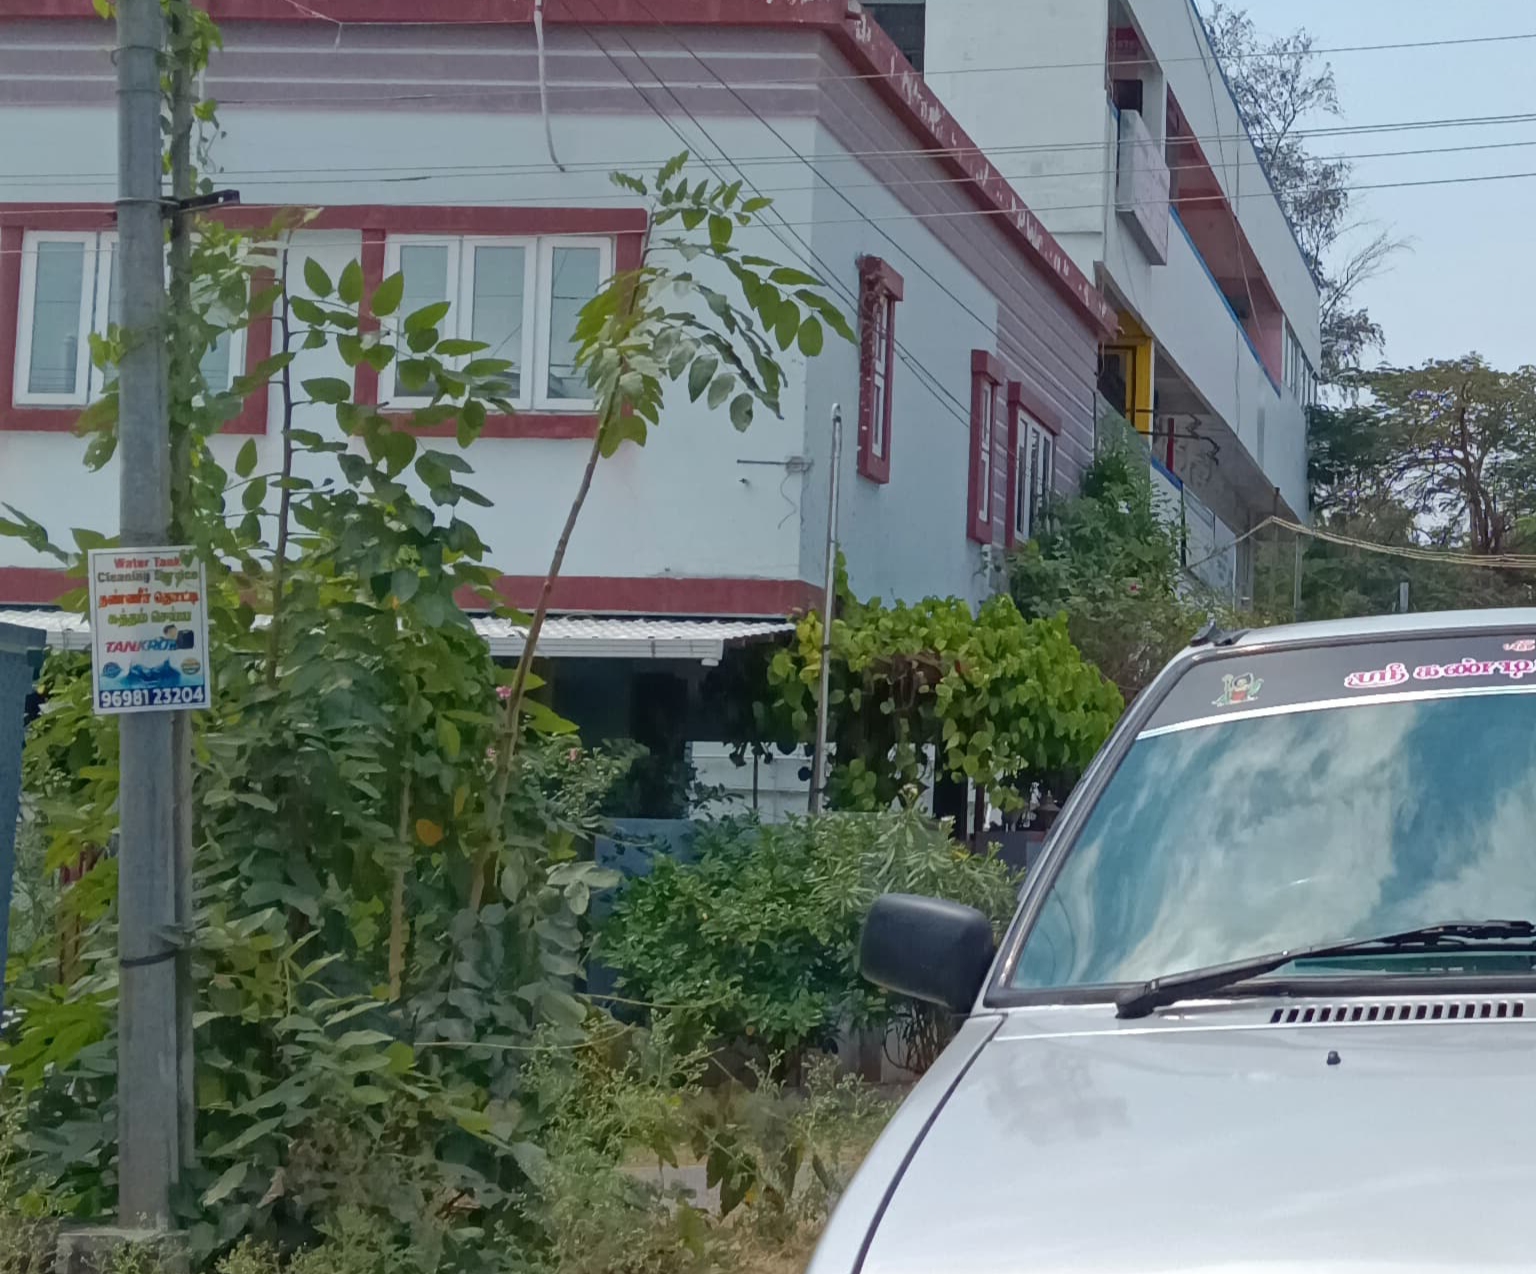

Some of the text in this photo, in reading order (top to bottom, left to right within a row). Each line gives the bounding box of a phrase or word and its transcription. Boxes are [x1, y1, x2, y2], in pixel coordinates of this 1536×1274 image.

[114, 558, 150, 569] Water
[97, 572, 150, 584] Cleaning
[1343, 662, 1410, 688] ஸ்ரீ
[101, 686, 204, 708] 96981 23204
